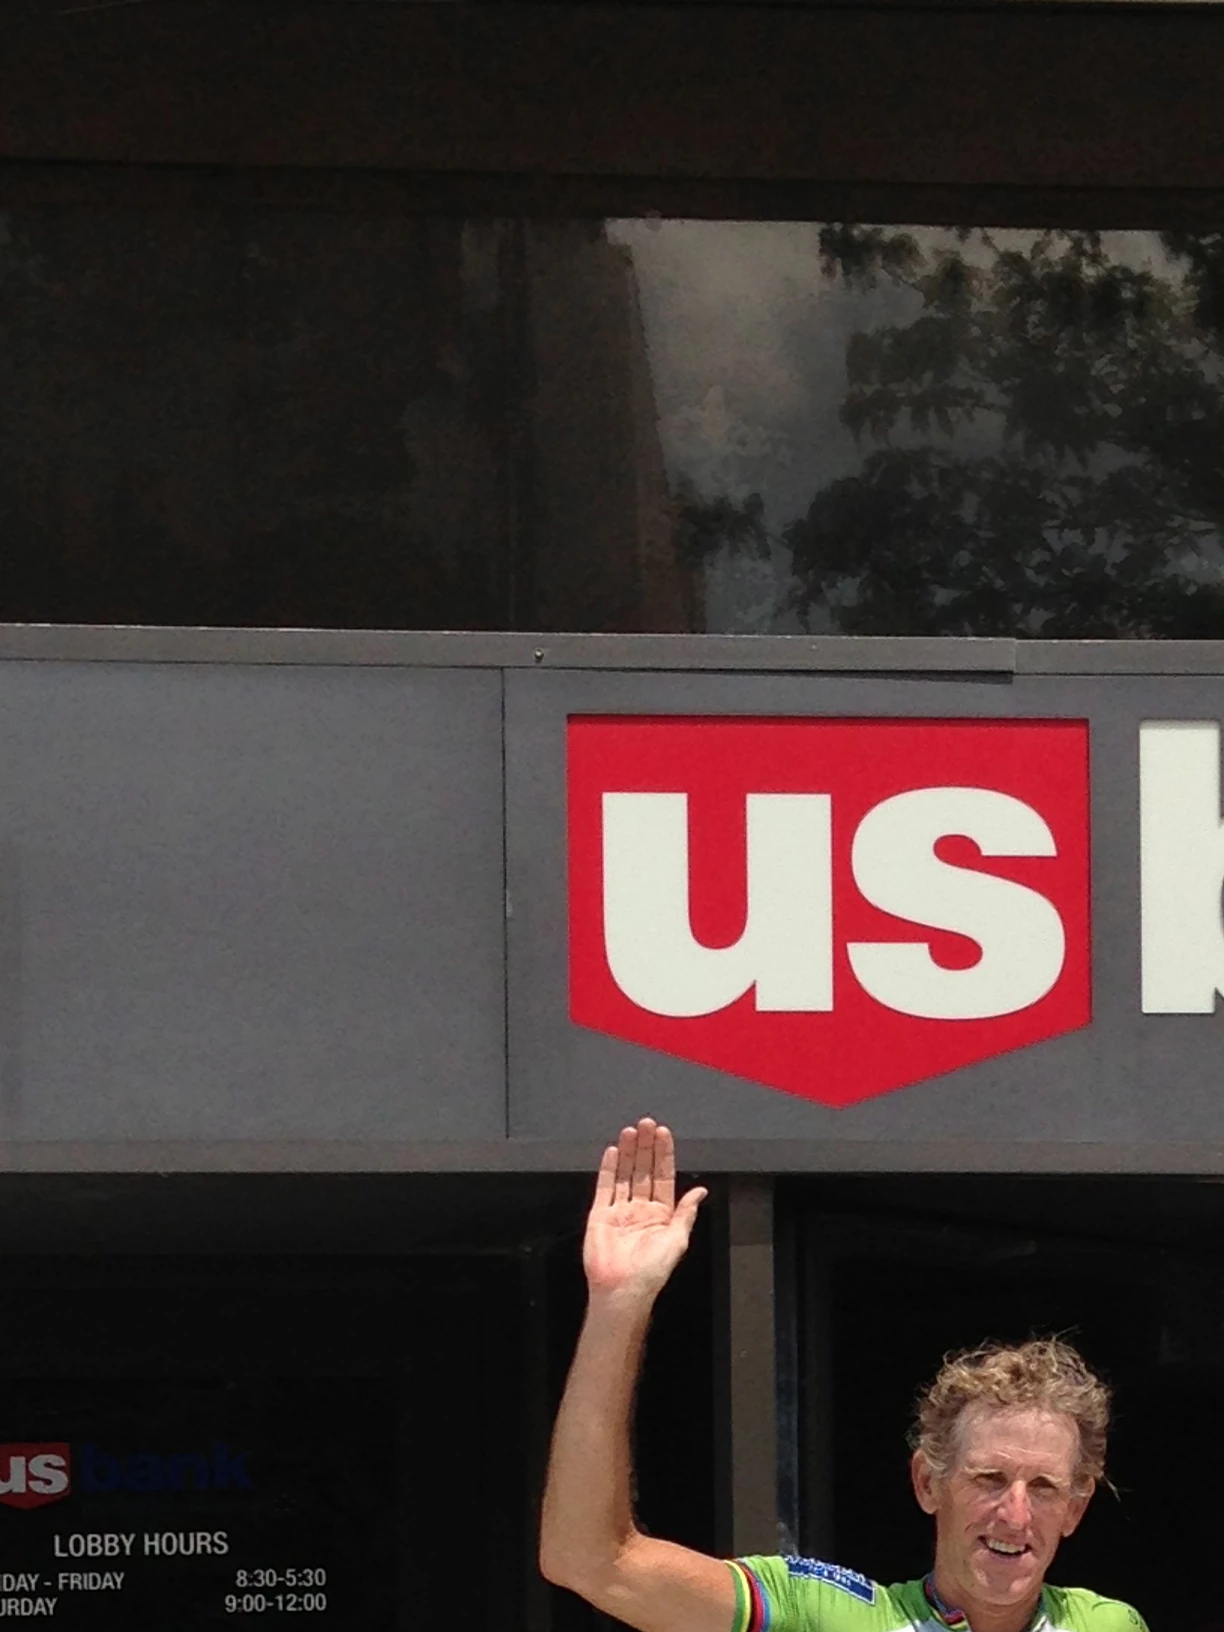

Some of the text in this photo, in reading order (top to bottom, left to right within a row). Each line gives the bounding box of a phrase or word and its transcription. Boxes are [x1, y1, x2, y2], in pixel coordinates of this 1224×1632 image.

[602, 786, 1066, 1021] us
[0, 1441, 255, 1494] us bank
[54, 1531, 229, 1557] LOBBY HOURS
[0, 1573, 39, 1592] DAY
[58, 1571, 125, 1590] FRIDAY
[235, 1568, 326, 1588] 8:30-5:30
[225, 1594, 327, 1613] 9:00-12:00
